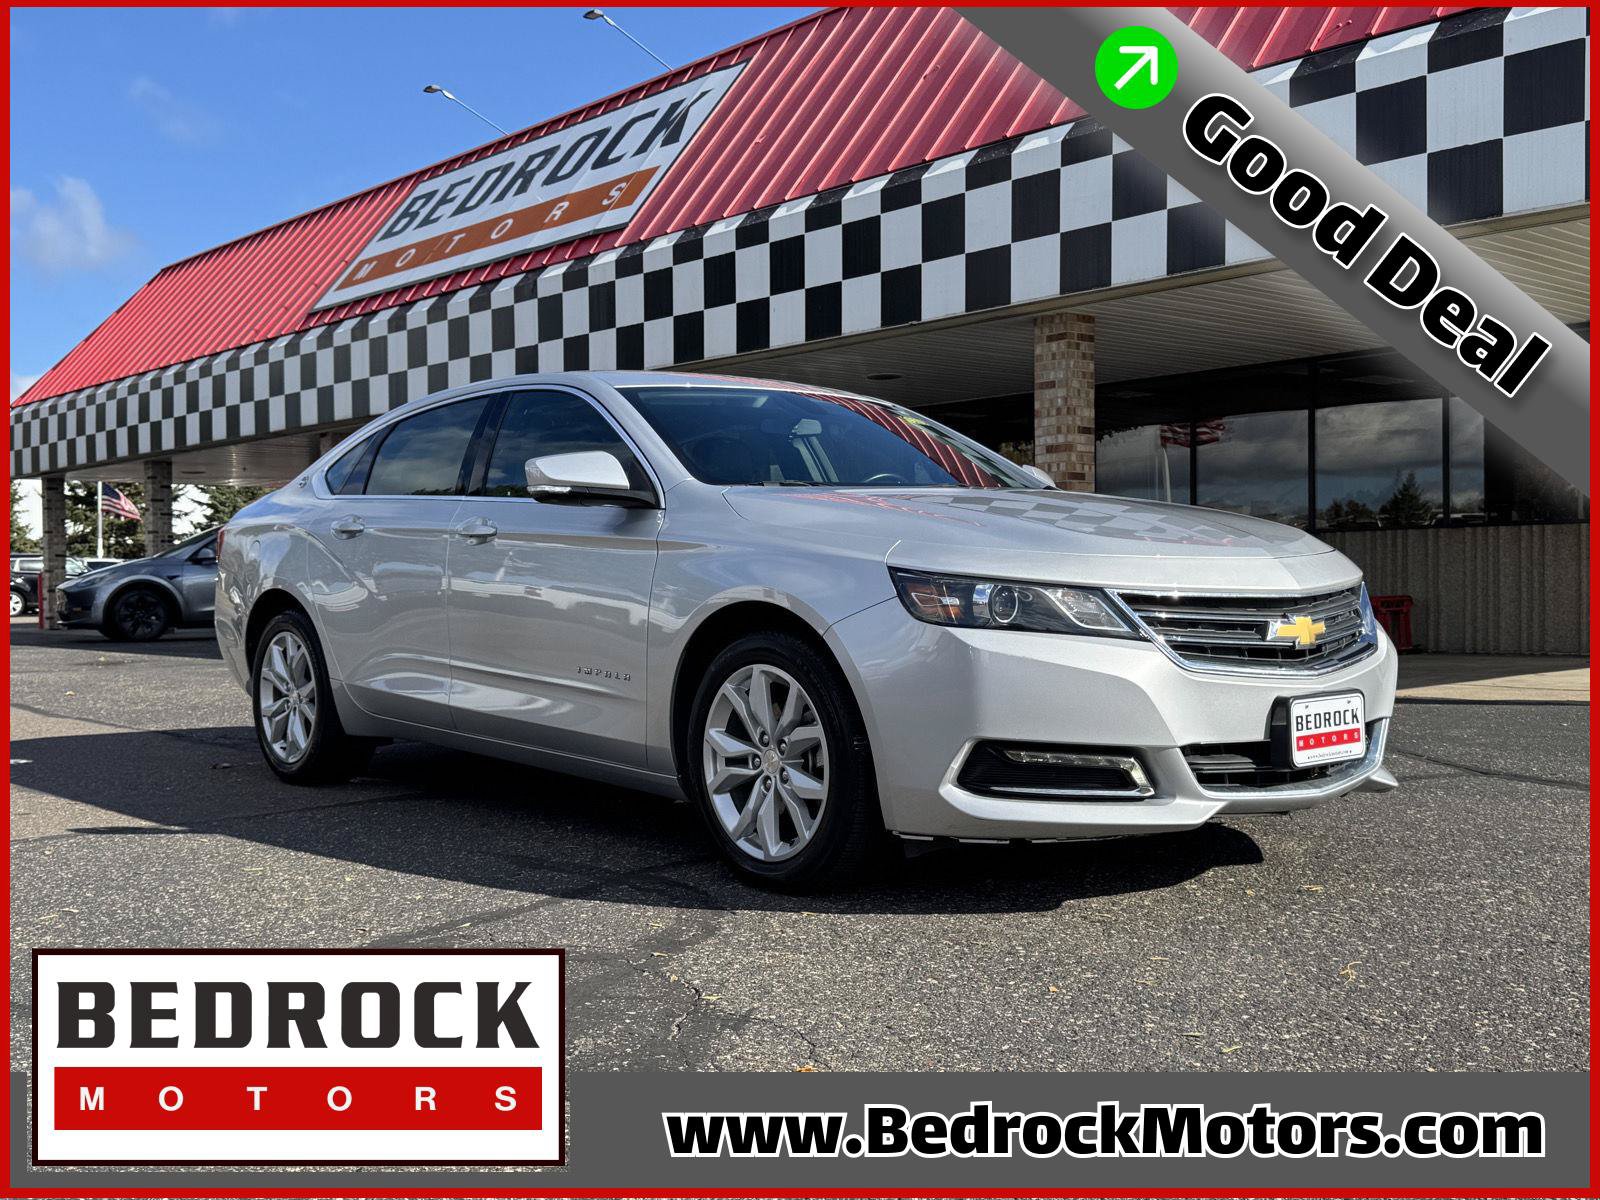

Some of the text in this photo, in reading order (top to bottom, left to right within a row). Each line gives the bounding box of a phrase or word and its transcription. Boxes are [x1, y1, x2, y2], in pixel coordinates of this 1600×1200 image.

[378, 89, 711, 242] BEDROCK
[352, 182, 628, 281] MOTORS
[577, 666, 631, 681] IMPALA
[1295, 707, 1360, 732] BEDROCK
[1299, 731, 1359, 747] MOTORS
